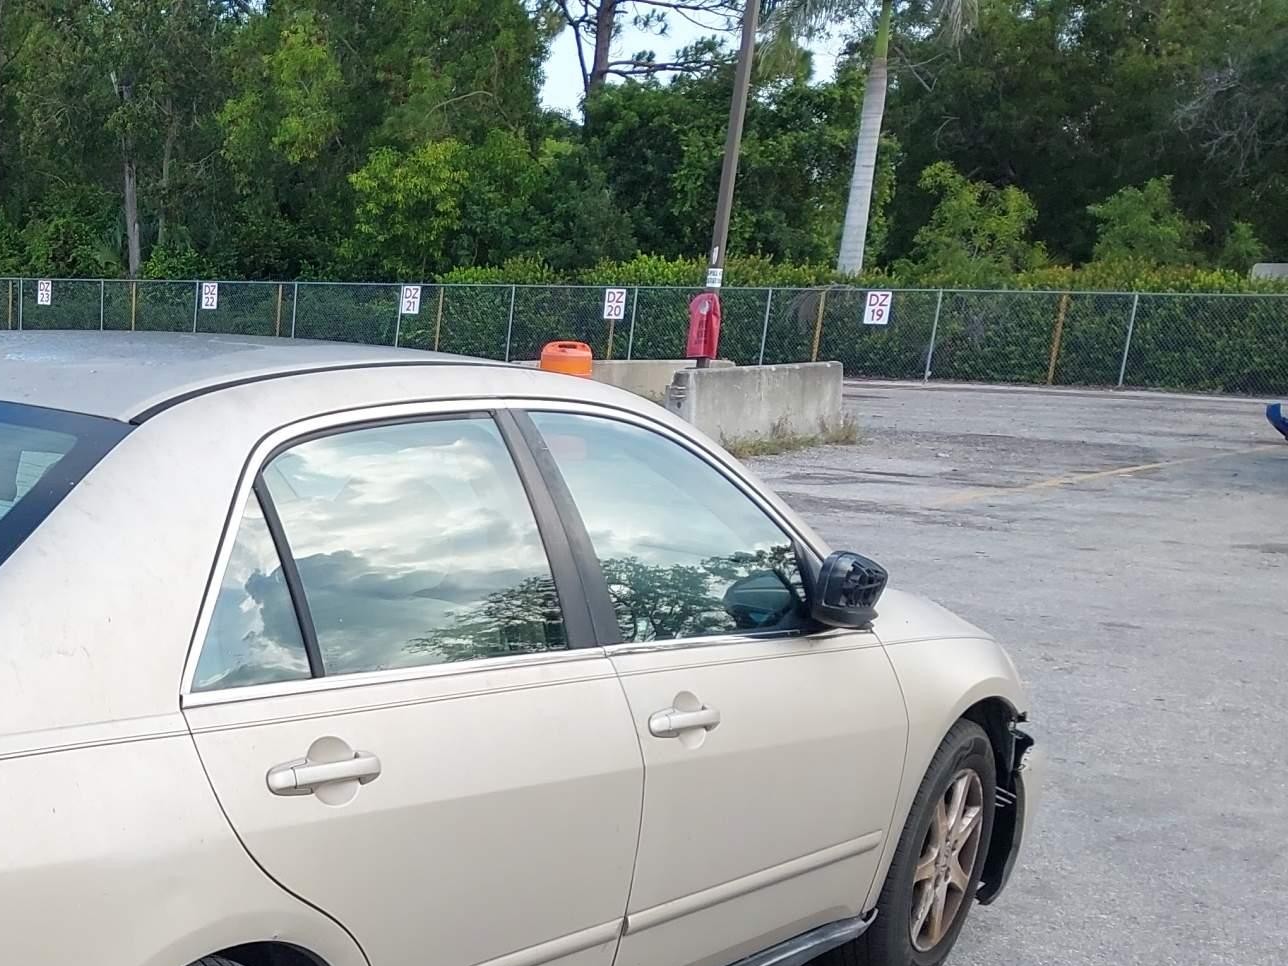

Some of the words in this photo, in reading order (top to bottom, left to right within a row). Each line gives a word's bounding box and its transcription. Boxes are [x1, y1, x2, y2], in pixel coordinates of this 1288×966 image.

[39, 281, 50, 292] DZ
[204, 284, 216, 295] DZ
[40, 293, 50, 303] 23
[404, 287, 418, 299] DZ
[607, 291, 624, 303] DZ
[205, 296, 215, 307] 22
[406, 300, 415, 312] 21
[868, 294, 889, 306] DZ
[607, 305, 621, 317] 20
[871, 308, 884, 321] 19
